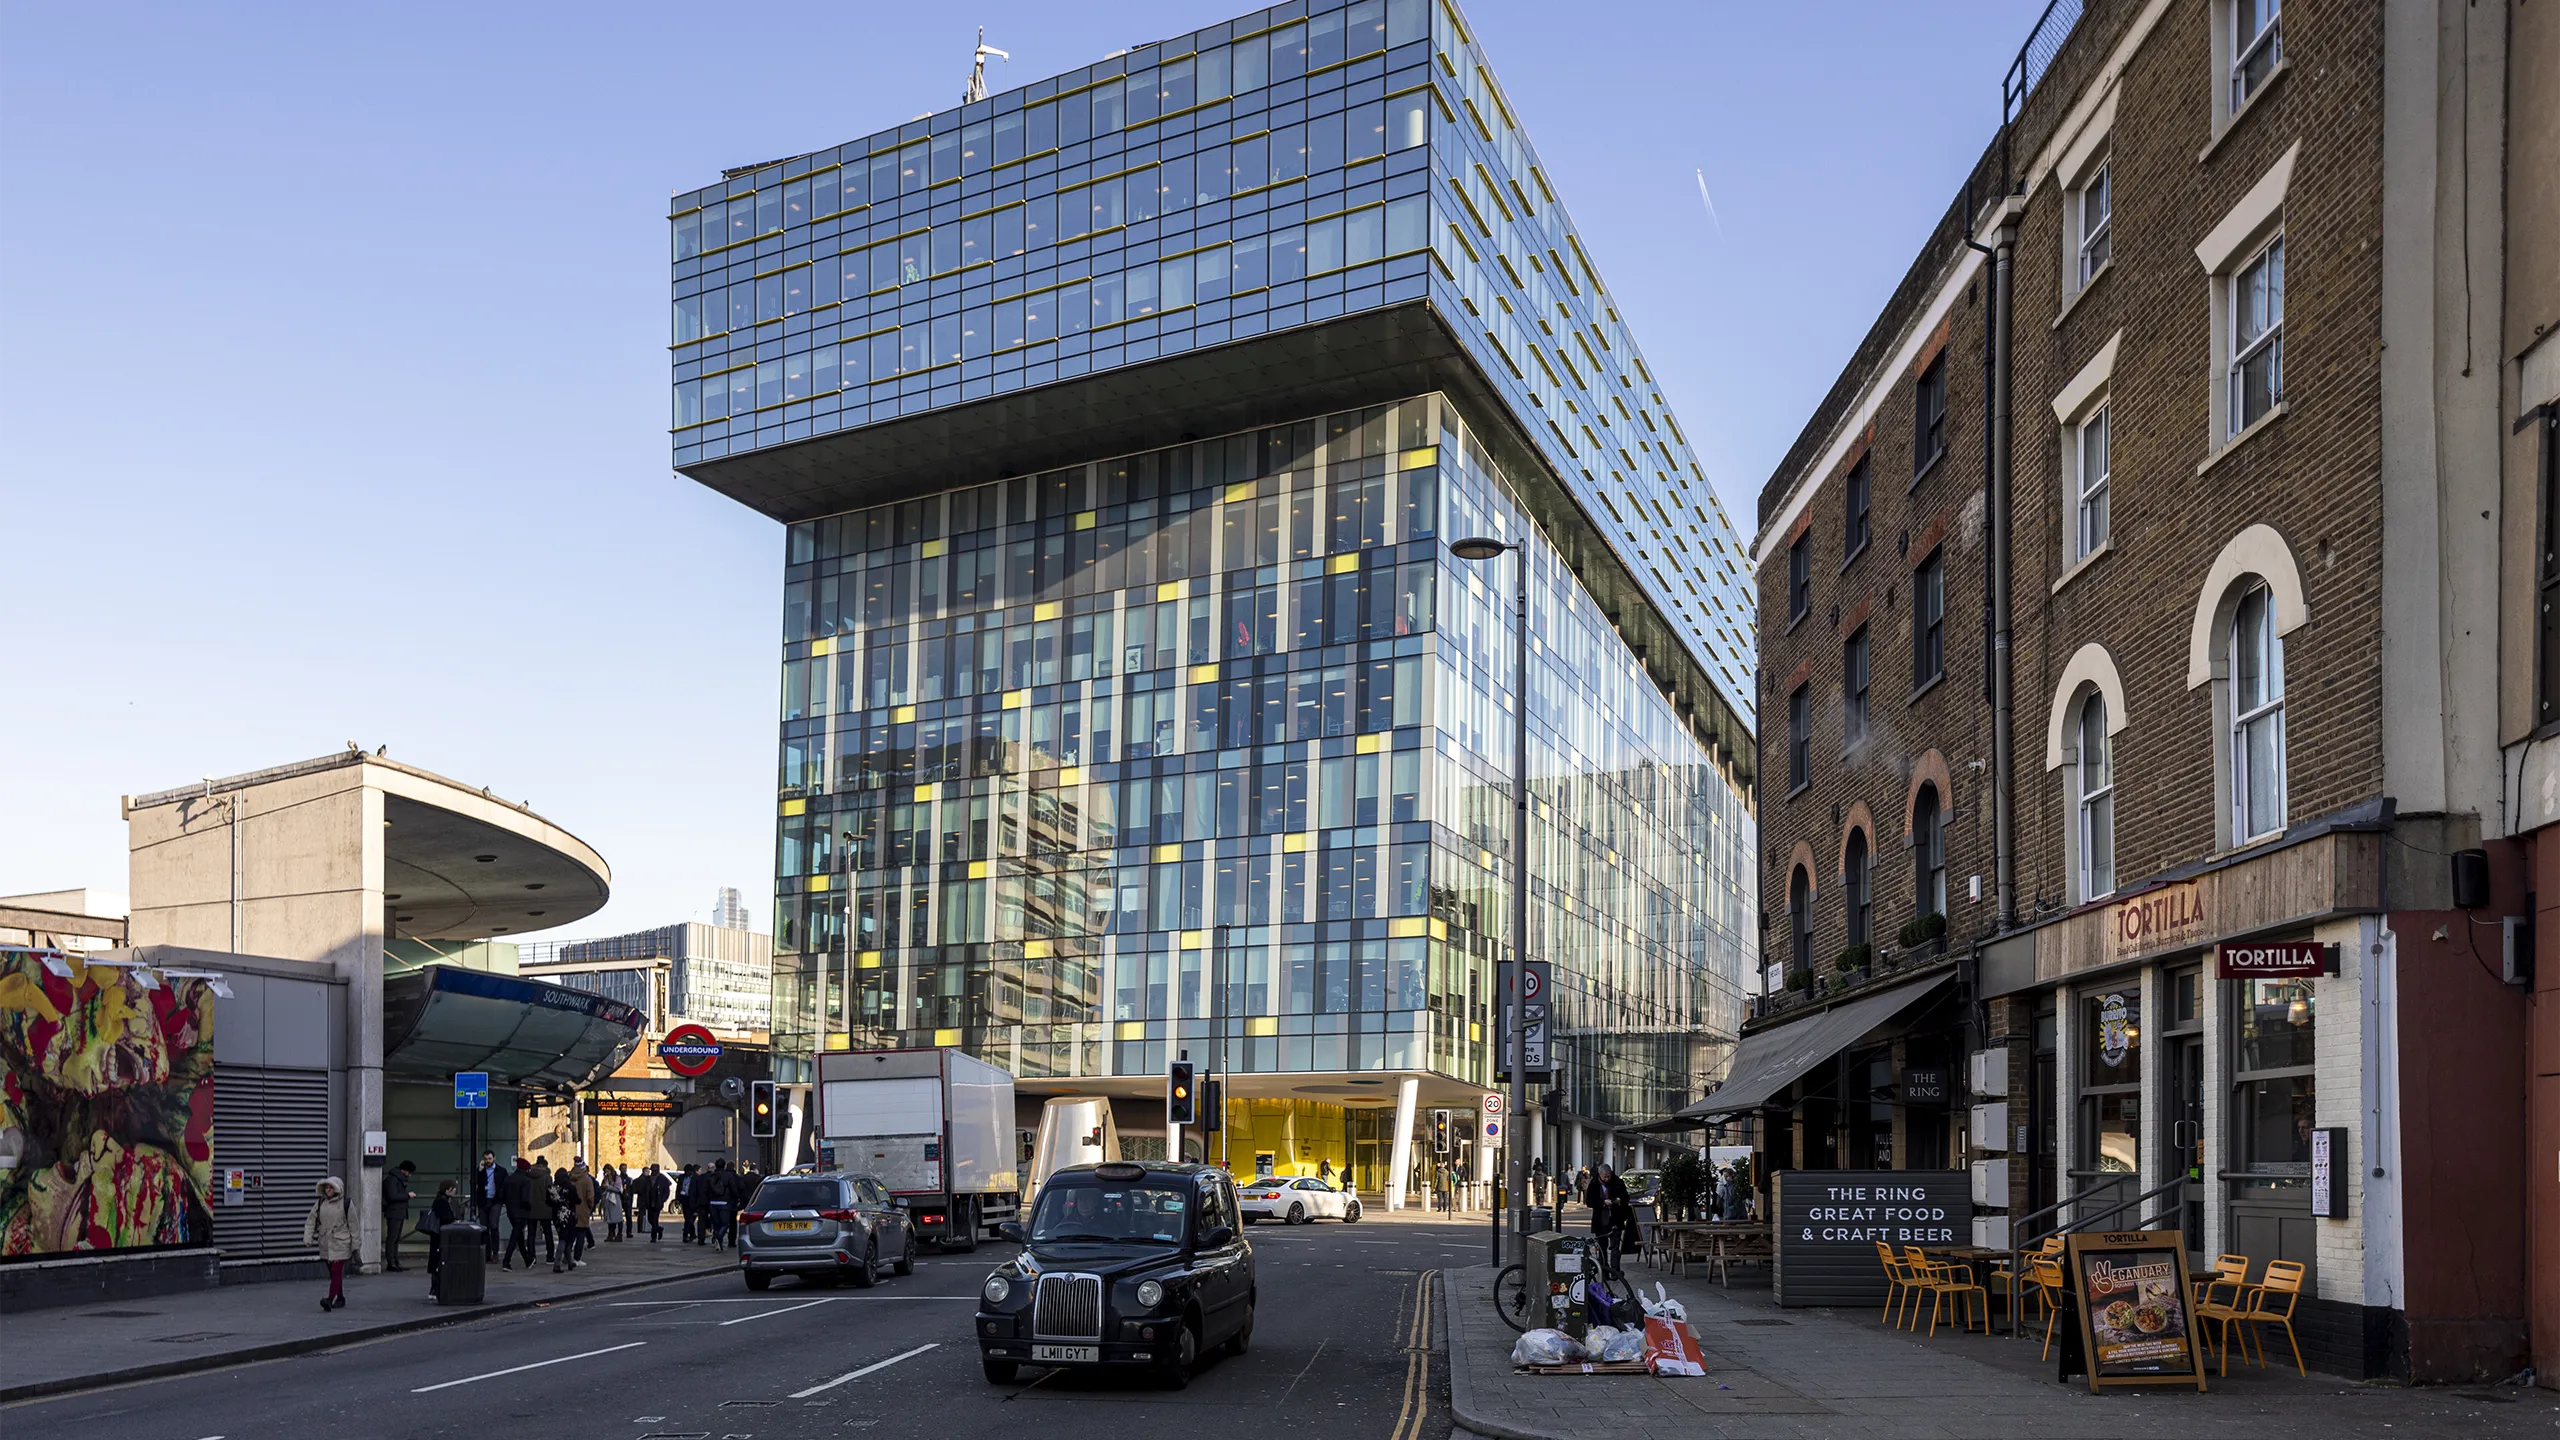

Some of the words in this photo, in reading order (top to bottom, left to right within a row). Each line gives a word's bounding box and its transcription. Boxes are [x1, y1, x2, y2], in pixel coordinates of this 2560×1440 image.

[2118, 888, 2204, 942] TORTILLA
[2187, 928, 2204, 939] Tacos
[2226, 949, 2316, 966] TORTILLA
[543, 990, 591, 1010] SOUTHWARK
[2101, 1007, 2127, 1022] BURRITO
[1913, 1074, 1936, 1083] THE
[1910, 1087, 1940, 1096] RING
[1878, 1150, 1890, 1161] AND
[1828, 1188, 1866, 1200] THE
[1876, 1188, 1926, 1200] RING
[1809, 1208, 1876, 1220] GREAT
[1885, 1208, 1944, 1220] FOOD
[1802, 1228, 1814, 1240] &
[1822, 1228, 1890, 1241] CRAFT
[1899, 1228, 1952, 1241] BEER
[2104, 1234, 2148, 1243] TORTILLA
[1042, 1347, 1062, 1359] LM11
[1066, 1348, 1089, 1359] GYT
